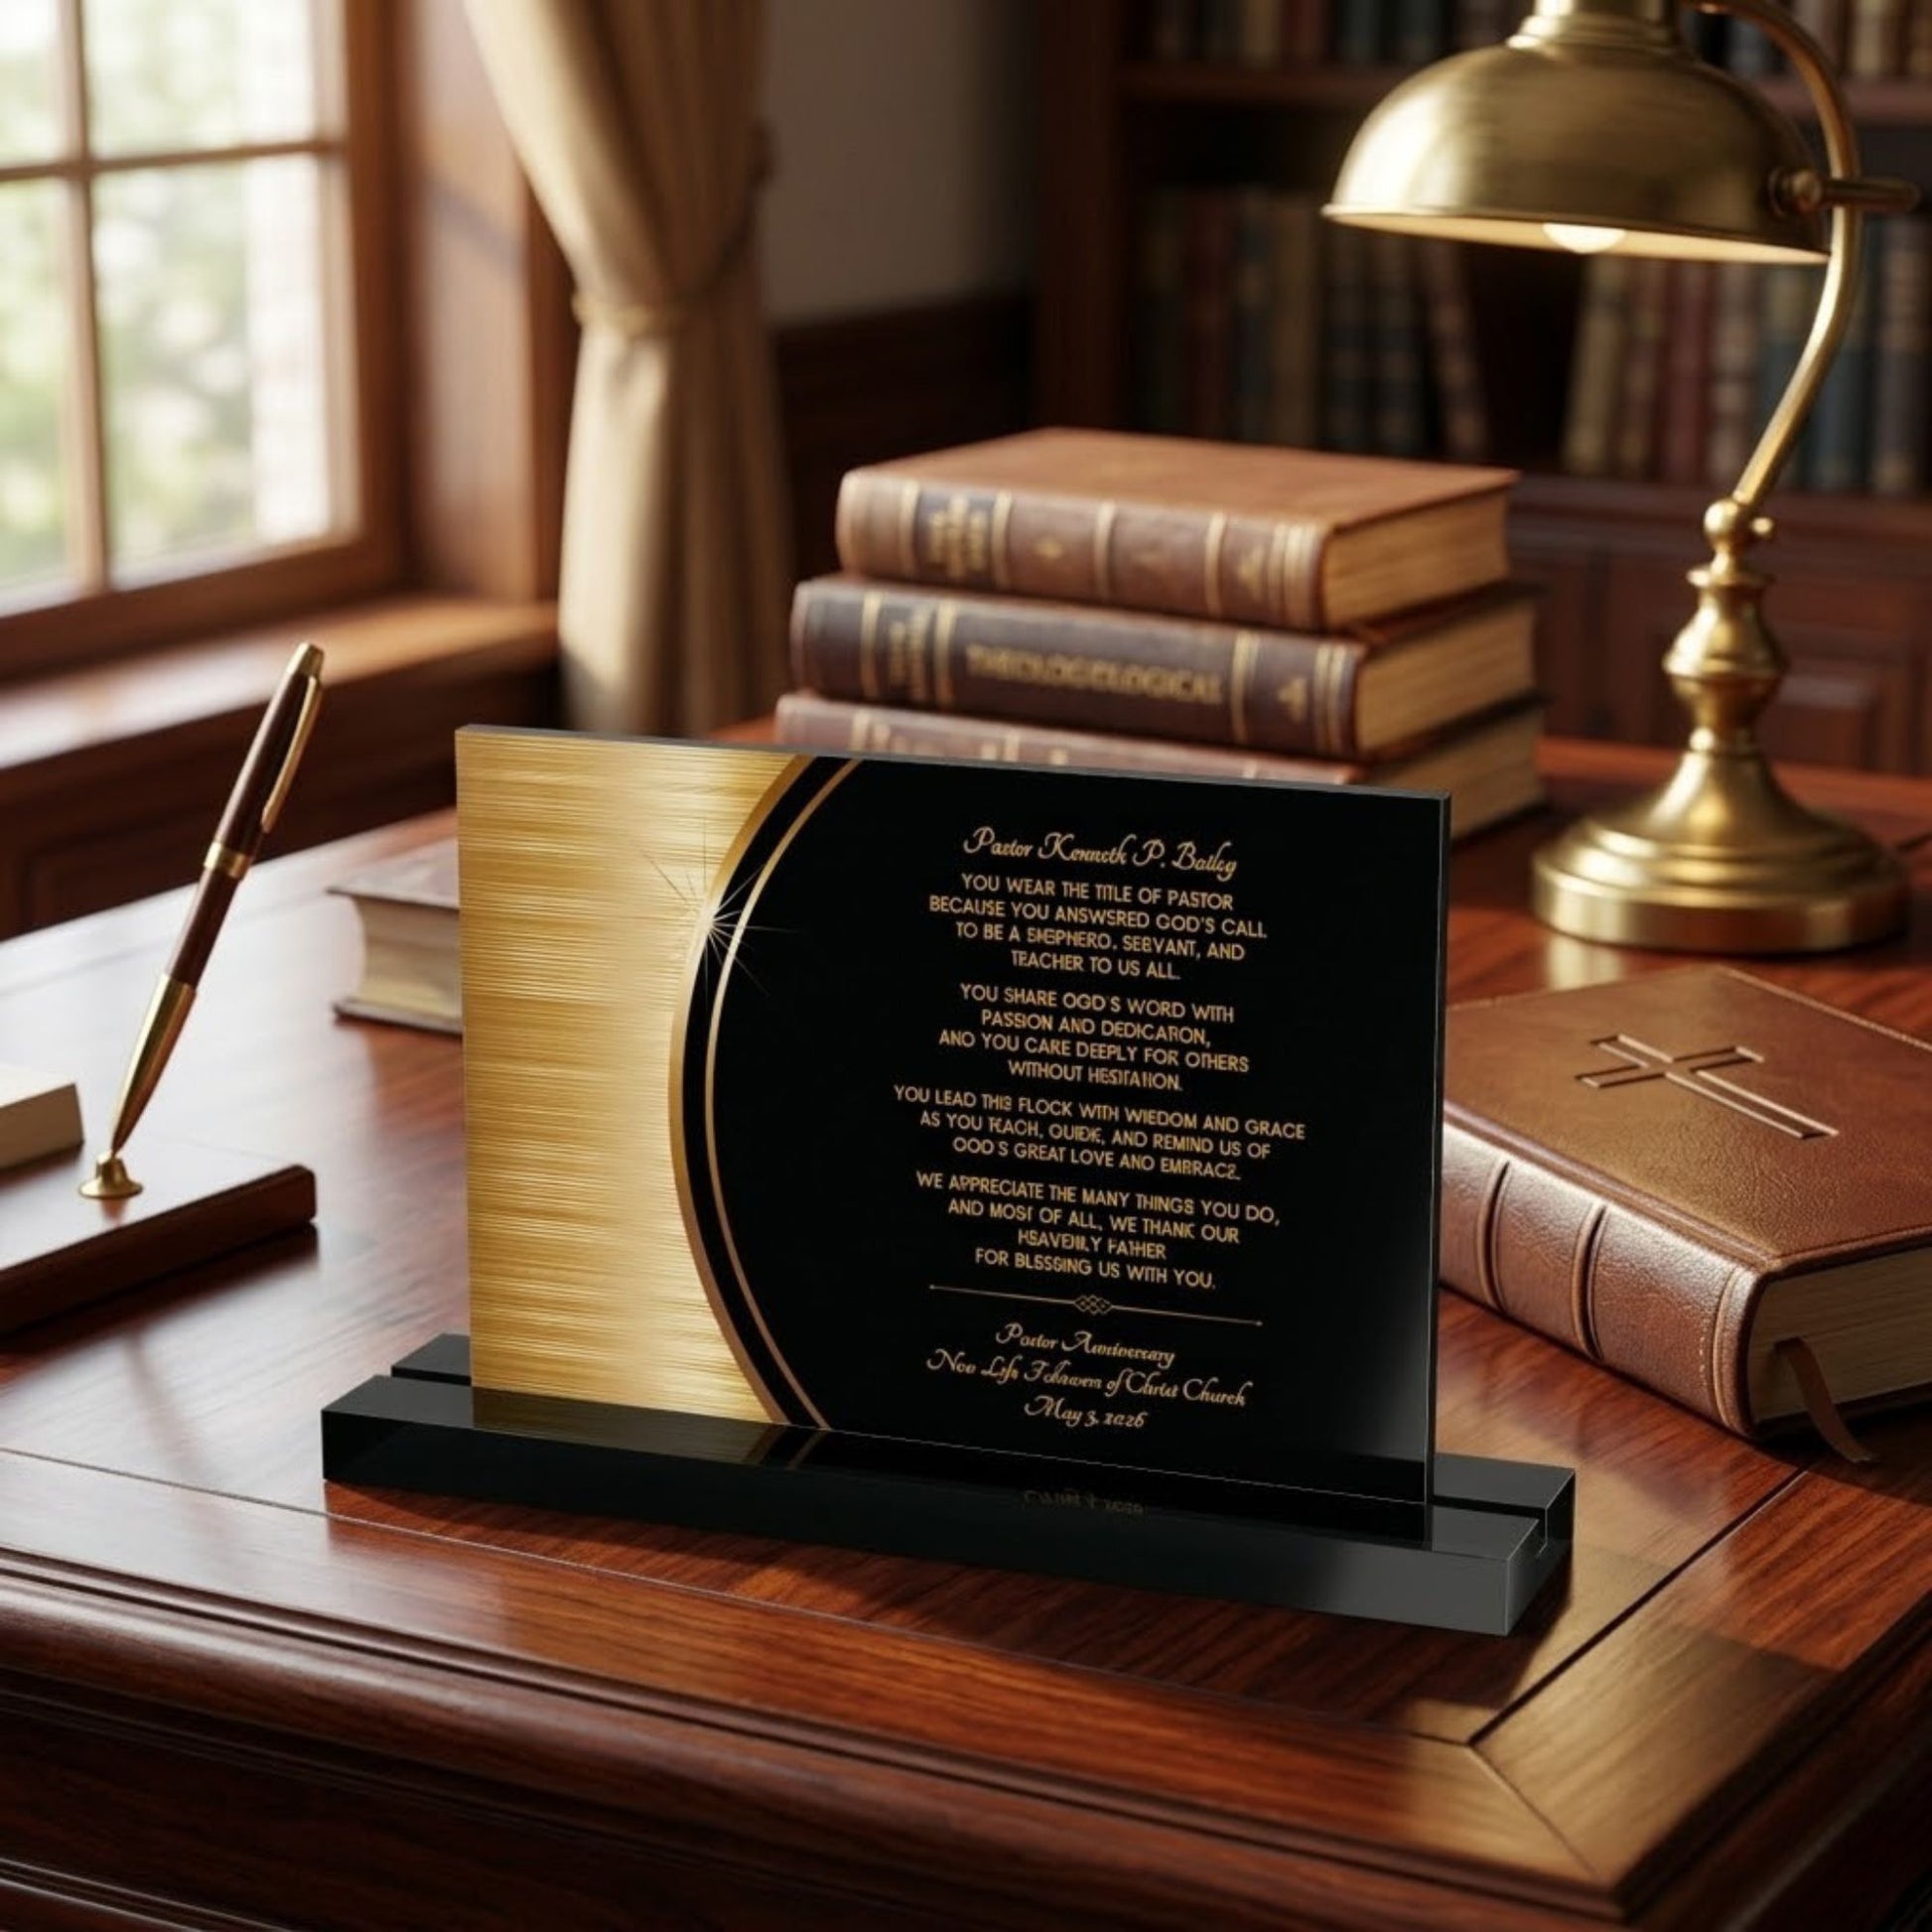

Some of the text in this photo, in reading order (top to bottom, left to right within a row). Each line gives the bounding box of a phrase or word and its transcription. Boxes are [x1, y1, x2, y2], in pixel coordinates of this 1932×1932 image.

[961, 873, 1001, 893] YOU
[1006, 877, 1056, 897] WEAR
[1061, 881, 1090, 899] THE
[1137, 887, 1163, 904] OF
[1167, 889, 1234, 911] PASTOR
[928, 895, 1006, 917] BECAUSE
[1010, 900, 1050, 920] YOU
[1155, 912, 1216, 934] GOD'S
[955, 921, 979, 939] TO
[982, 922, 1004, 941] BE
[1008, 924, 1021, 942] A
[1206, 941, 1246, 961] AND
[1089, 955, 1113, 975] TO
[1117, 958, 1141, 977] US
[960, 983, 999, 1003] YOU
[1004, 986, 1058, 1008] SHARE
[1126, 998, 1186, 1019] WORD
[1191, 1003, 1234, 1024] WITH
[981, 1032, 1020, 1052] YOU
[1024, 1036, 1071, 1057] CARE
[1075, 1040, 1139, 1062] DEEPLY
[1143, 1046, 1179, 1066] FOR
[894, 1084, 931, 1103] YOU
[934, 1089, 977, 1108] LEAD
[1018, 1096, 1073, 1117] FLOCK
[1202, 1114, 1240, 1134] AND
[1244, 1118, 1306, 1141] GRACE
[919, 1110, 941, 1128] AS
[946, 1113, 983, 1132] YOU
[1111, 1129, 1149, 1148] AND
[1152, 1133, 1214, 1155] REMIND
[1218, 1139, 1242, 1158] US
[1246, 1142, 1271, 1160] OF
[1013, 1142, 1067, 1163] GREAT
[1070, 1148, 1115, 1168] LOVE
[915, 1171, 943, 1189] WE
[1048, 1183, 1077, 1203] THE
[1081, 1187, 1131, 1208] MANY
[1135, 1192, 1195, 1216] THINGS
[1200, 1199, 1240, 1220] YOU
[1245, 1204, 1280, 1226] DO,
[948, 1197, 985, 1216] AND
[1038, 1206, 1062, 1225] OF
[1109, 1214, 1138, 1233] WE
[1200, 1223, 1240, 1244] OUR
[974, 1247, 1010, 1267] FOR
[1098, 1261, 1121, 1280] US
